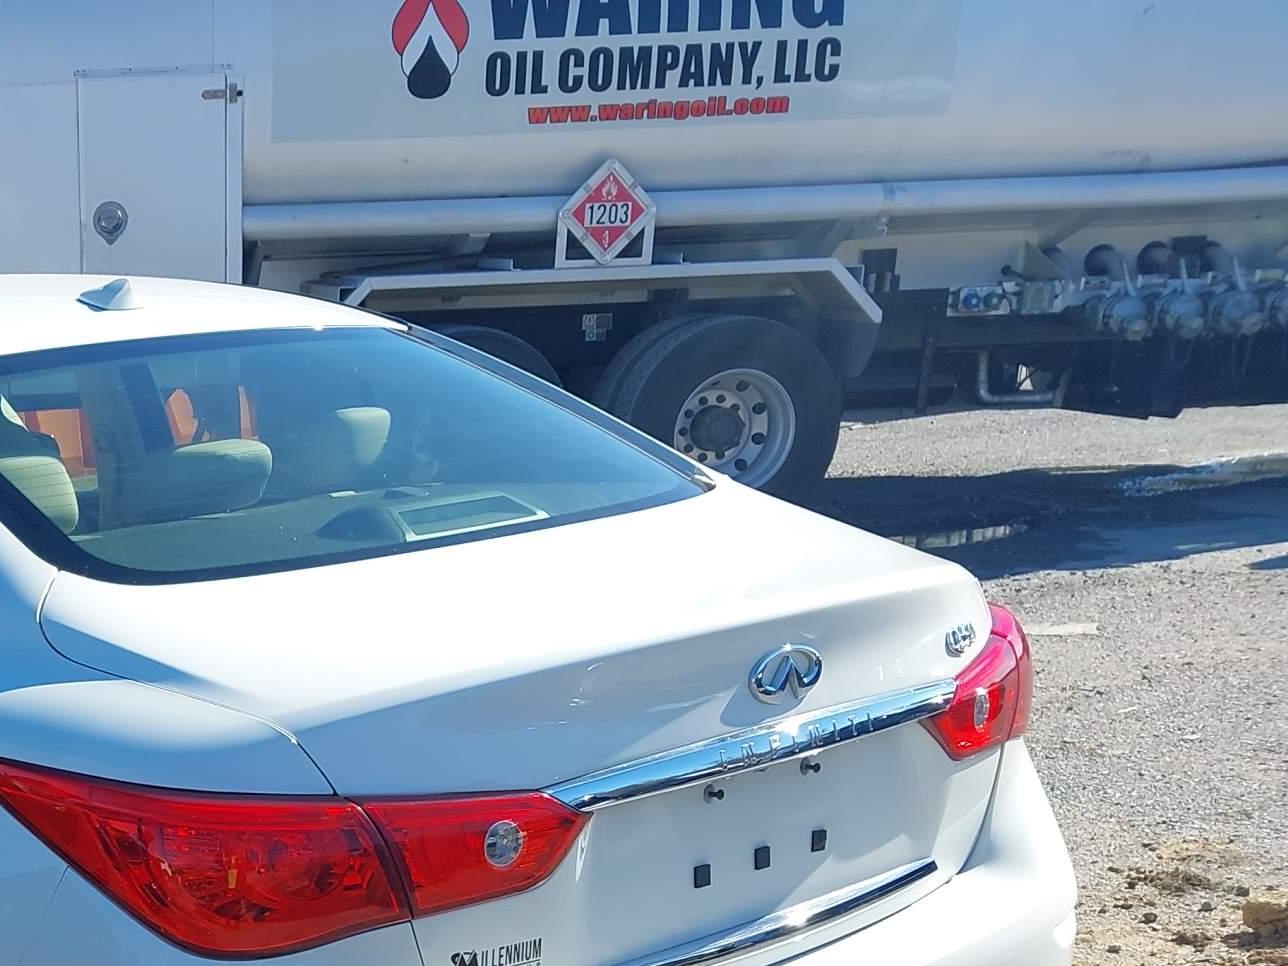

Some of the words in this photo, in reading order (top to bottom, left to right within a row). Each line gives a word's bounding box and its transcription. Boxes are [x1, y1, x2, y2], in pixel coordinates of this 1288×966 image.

[485, 50, 549, 97] OIL
[557, 40, 764, 94] COMPANY,
[773, 37, 843, 84] LLC
[527, 95, 791, 125] www.waringoil.com
[587, 202, 631, 226] 1203
